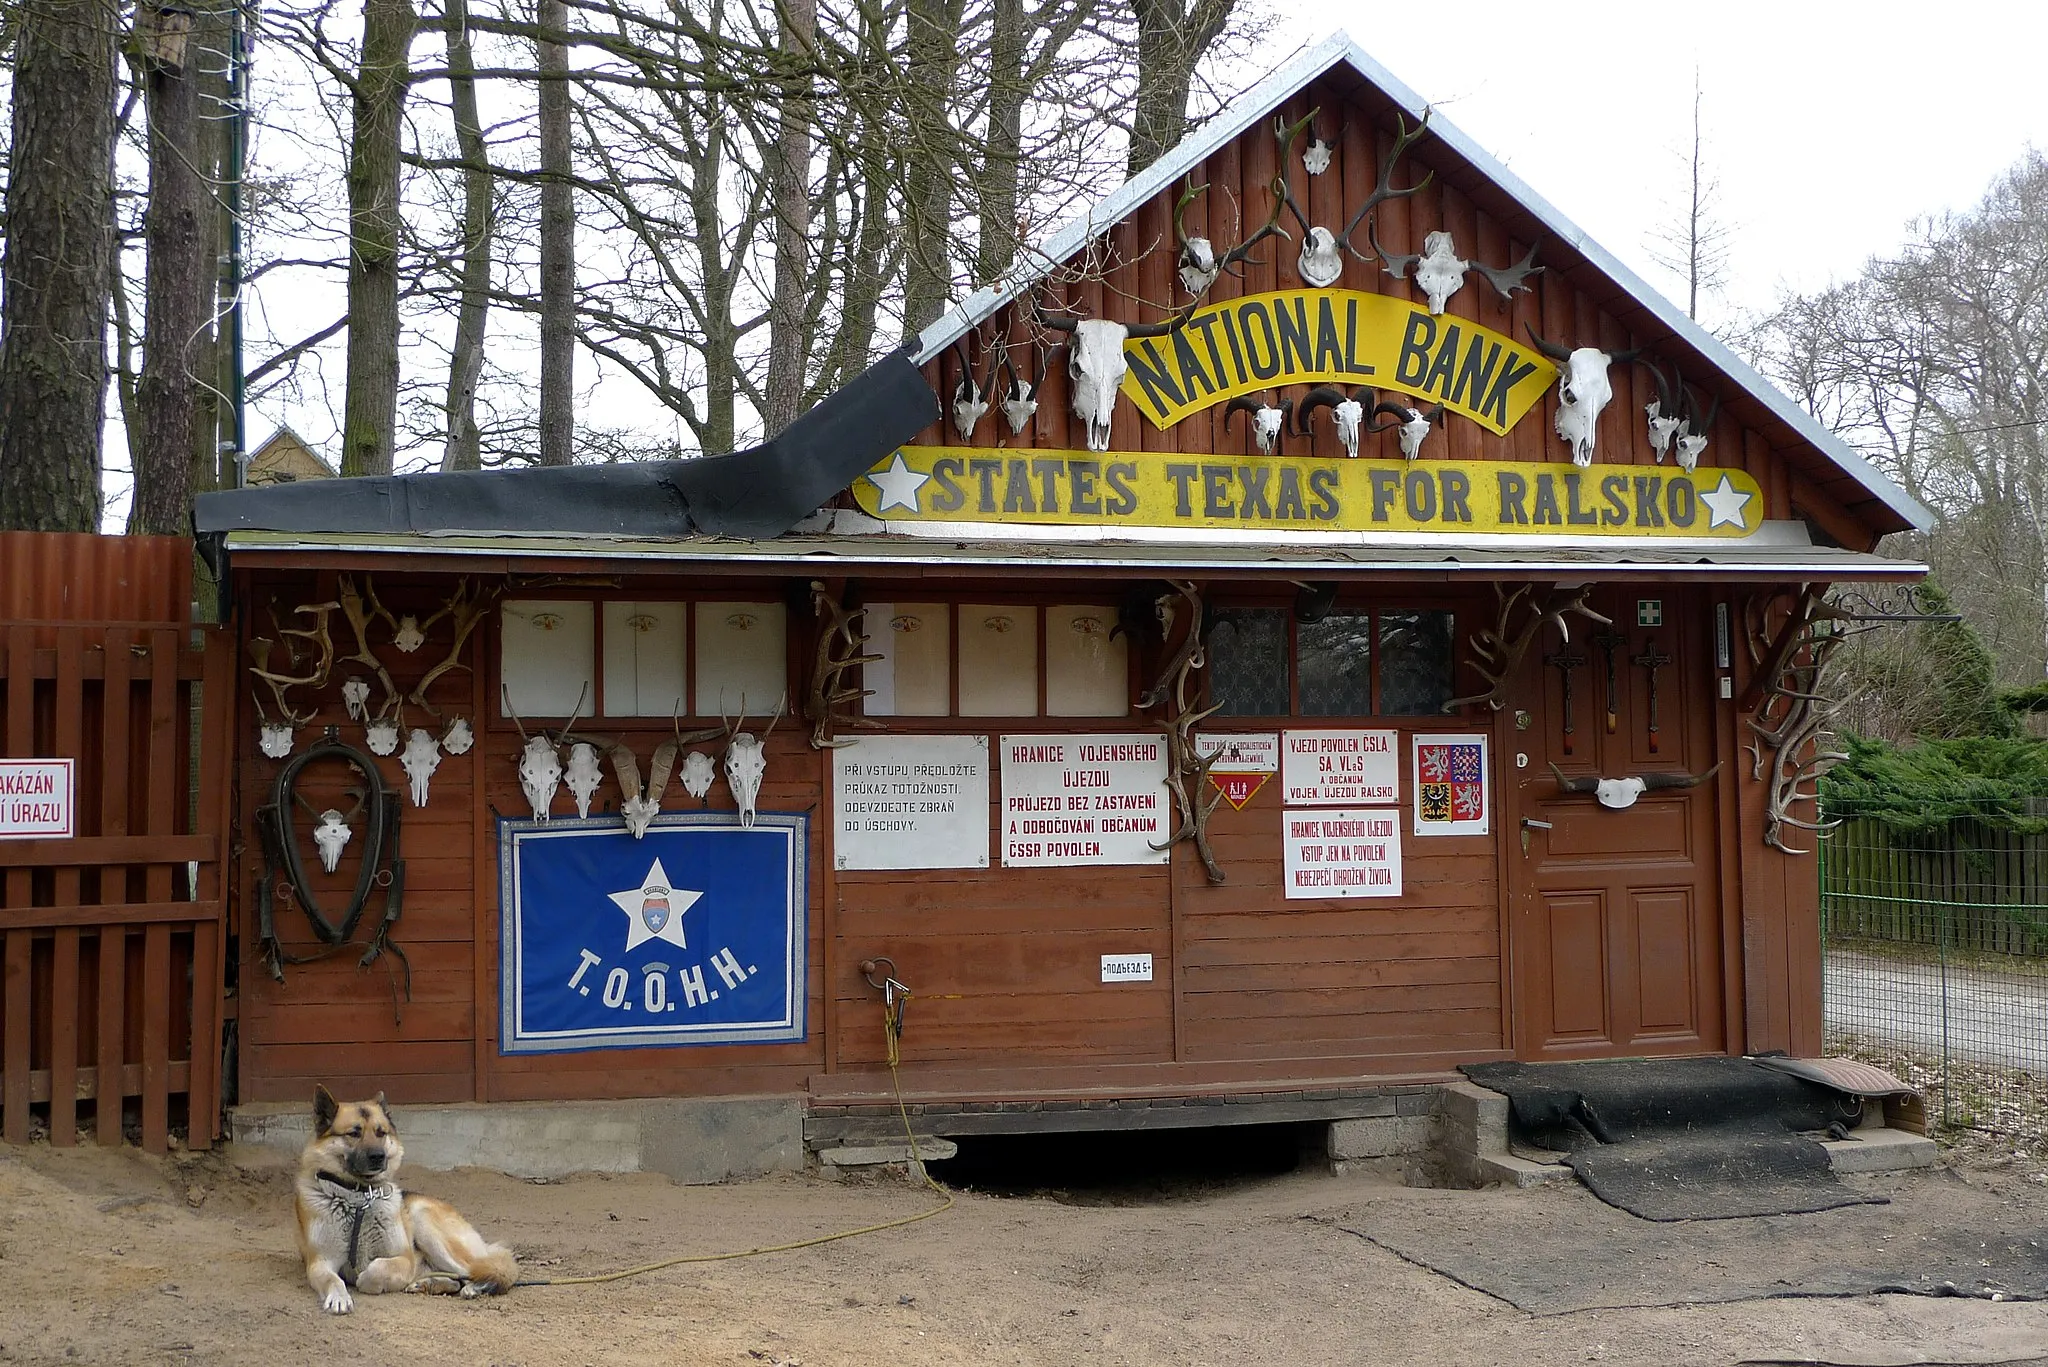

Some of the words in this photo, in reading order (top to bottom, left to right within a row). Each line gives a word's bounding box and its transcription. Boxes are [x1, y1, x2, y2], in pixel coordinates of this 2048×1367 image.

[1129, 296, 1375, 418] NATIONAL
[1395, 310, 1537, 428] BANK
[931, 456, 1137, 517] STATES
[1167, 463, 1340, 521] TEXAS
[1369, 468, 1472, 522] FOR
[1497, 471, 1696, 528] RALSKO
[1012, 745, 1064, 763] HRANICE
[1079, 741, 1157, 762] VOJENSKÉHO
[1290, 739, 1318, 753] VJEZD
[1321, 738, 1358, 753] POVOLEN
[1363, 734, 1391, 753] ČSLA,
[844, 763, 862, 776] PŘI
[866, 765, 908, 776] VSTUPU
[914, 763, 977, 776] PŘEDLOŽTE
[1319, 756, 1335, 773] SA,
[1339, 756, 1364, 772] VLaS
[892, 781, 961, 794] TOTOŽNOSTI.
[1063, 768, 1110, 788] ÚJEZDU
[1320, 775, 1326, 785] A
[1290, 787, 1320, 799] VOJEN.
[1324, 785, 1357, 799] ÚJEZDU
[1361, 786, 1393, 798] RALSKO
[11, 798, 60, 823] ÚRAZU
[845, 802, 916, 813] ODEVZDEJTE
[919, 800, 955, 813] ZBRAŇ
[1009, 794, 1061, 812] PRŮJEZD
[1068, 796, 1089, 811] BEZ
[1095, 792, 1156, 810] ZASTAVENÍ
[845, 821, 859, 831] DO
[865, 818, 917, 831] ÚSCHOVY.
[1009, 820, 1018, 835] A
[1022, 816, 1095, 834] ODBOČOVÁNÍ
[1101, 814, 1157, 833] OBČANŮM
[1291, 821, 1320, 838] HRANICE
[1322, 819, 1365, 838] VOJENSKÉHO
[1367, 819, 1393, 837] ÚJEZDU
[1009, 840, 1041, 858] ČSSR
[1047, 842, 1104, 858] POVOLEN.
[1300, 845, 1323, 862] VSTUP
[1326, 845, 1339, 862] JEN
[1341, 845, 1351, 862] NA
[1353, 843, 1386, 861] POVOLENÍ
[1295, 868, 1332, 887] NEBEZPEČÍ
[1333, 867, 1366, 886] OHROŽENÍ
[1368, 867, 1392, 886] ŽIVOTA
[1142, 962, 1147, 973] 5
